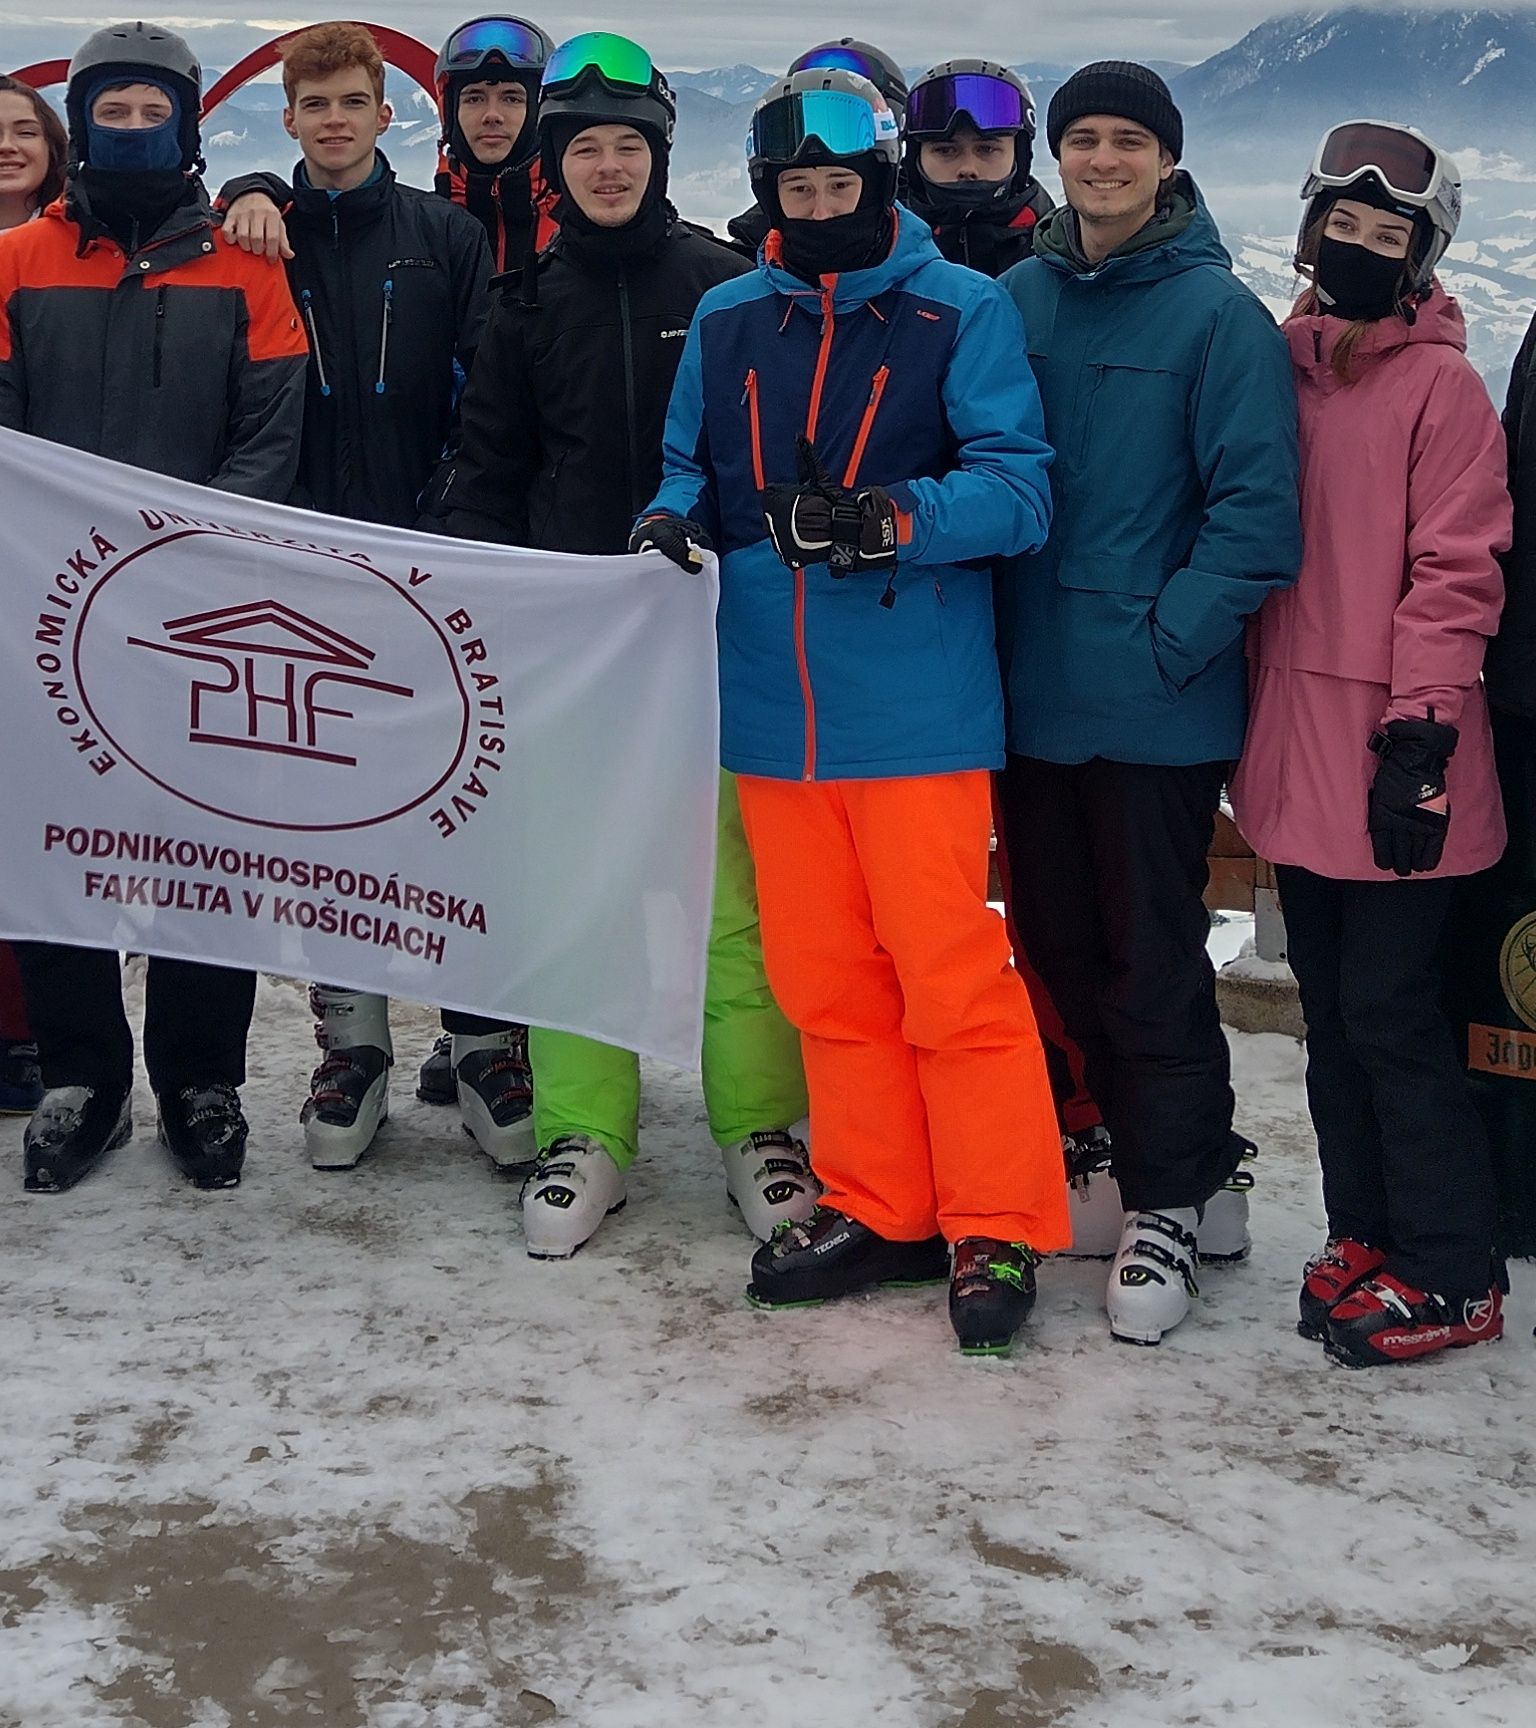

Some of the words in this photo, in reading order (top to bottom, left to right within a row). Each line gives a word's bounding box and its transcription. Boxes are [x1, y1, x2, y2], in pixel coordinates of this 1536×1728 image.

[35, 526, 118, 776] EKONOMICKÁ
[408, 566, 432, 587] V
[429, 608, 505, 838] BRATISLAVE
[44, 823, 487, 934] PODNIKOVOHOSPODÁRSKA
[84, 871, 232, 915] FAKULTA
[242, 890, 263, 919] V
[272, 896, 446, 965] KOŠICIACH
